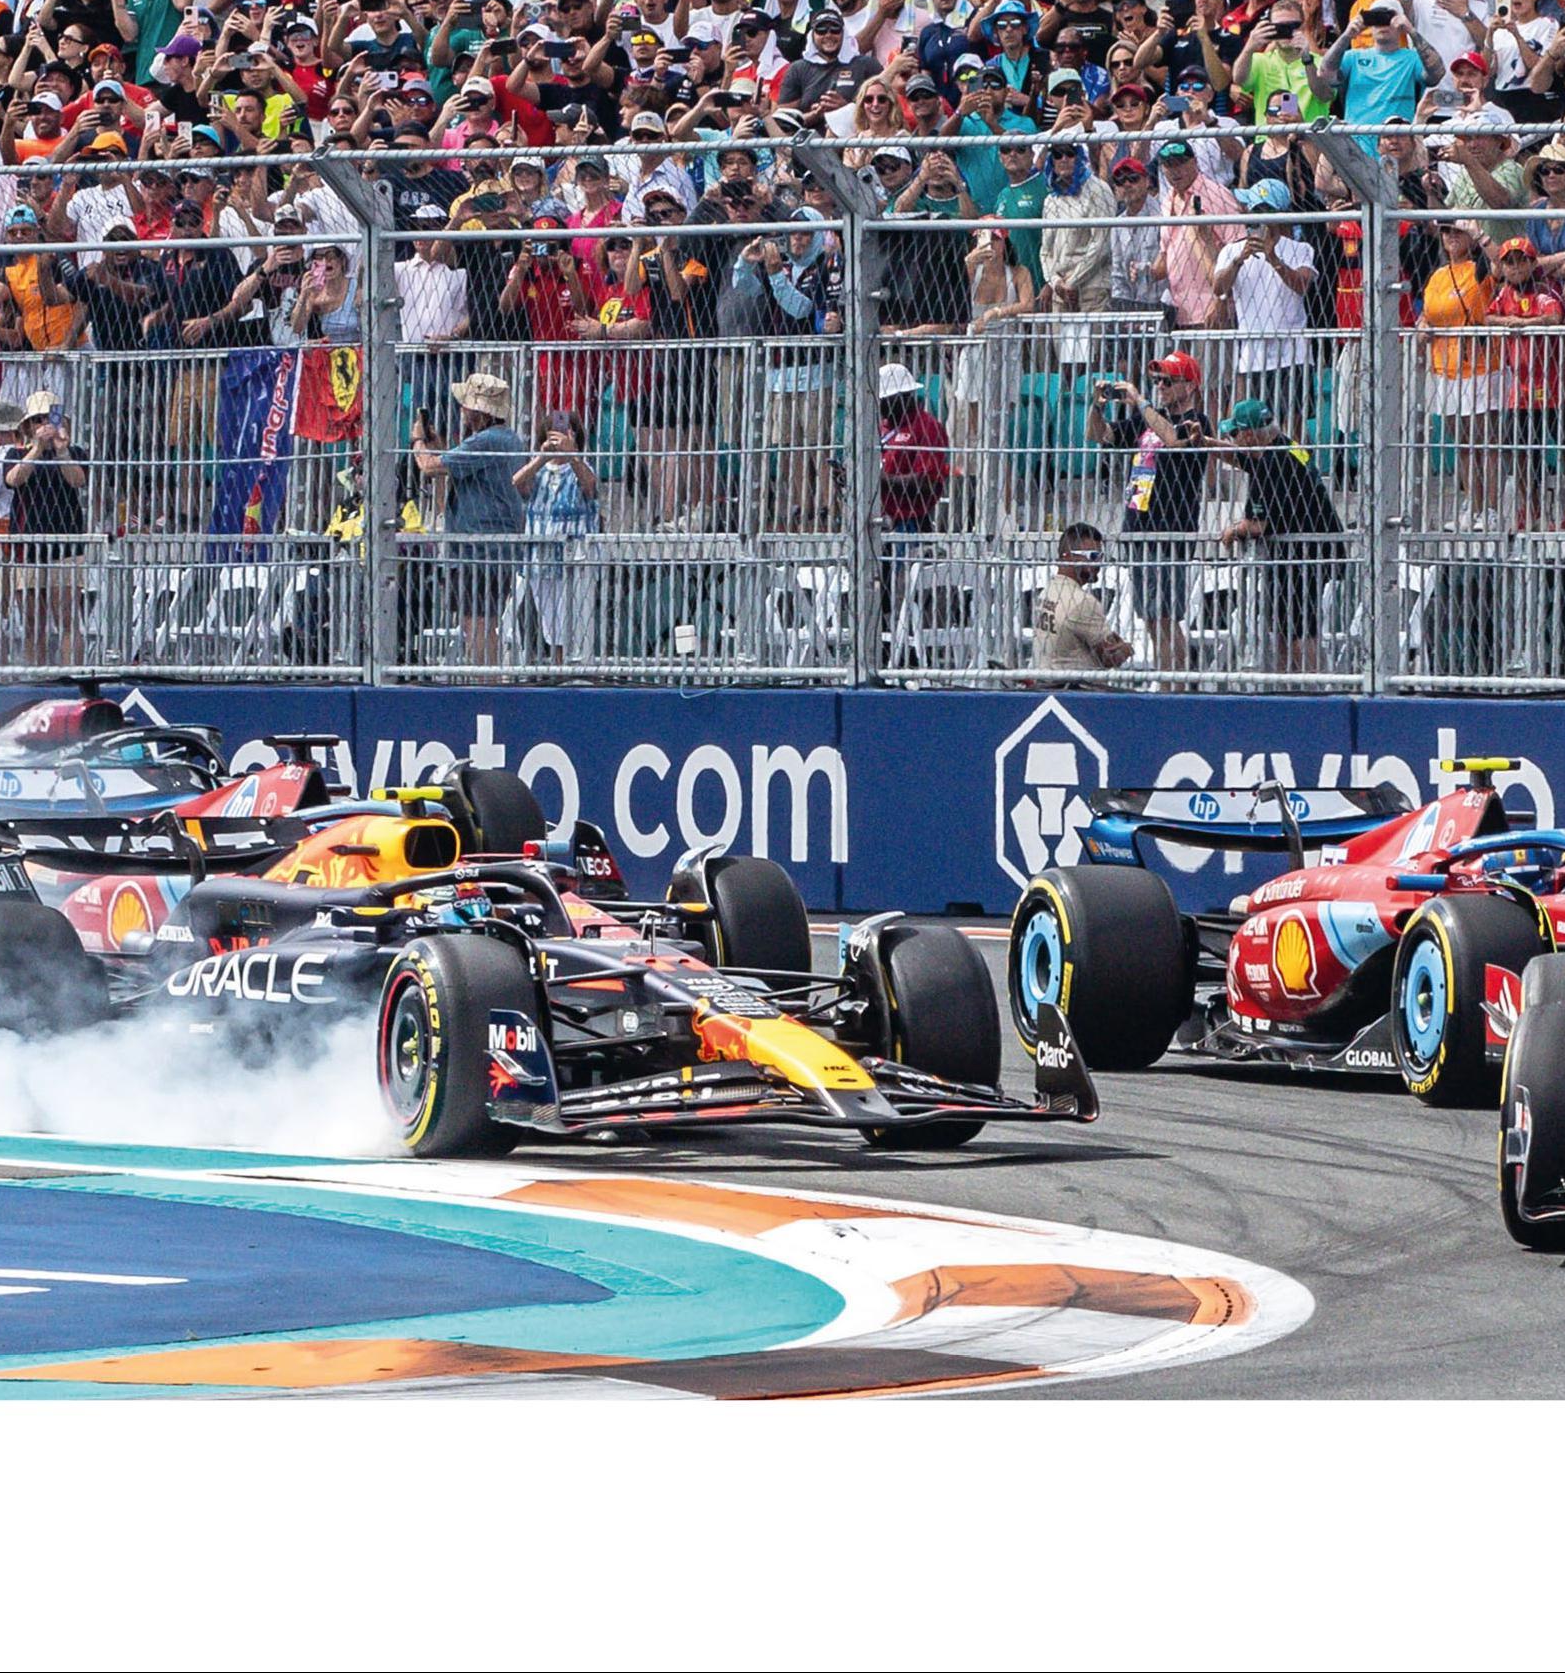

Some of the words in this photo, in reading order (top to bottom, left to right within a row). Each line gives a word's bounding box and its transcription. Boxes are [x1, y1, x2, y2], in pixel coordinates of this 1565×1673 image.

[229, 713, 849, 863] ytocom
[1192, 793, 1219, 820] hp
[1263, 876, 1307, 903] Santander
[168, 952, 338, 1005] ORACLE
[488, 1023, 537, 1053] Mobil
[1036, 1039, 1069, 1069] Claro
[1346, 1049, 1396, 1067] GLOBAL
